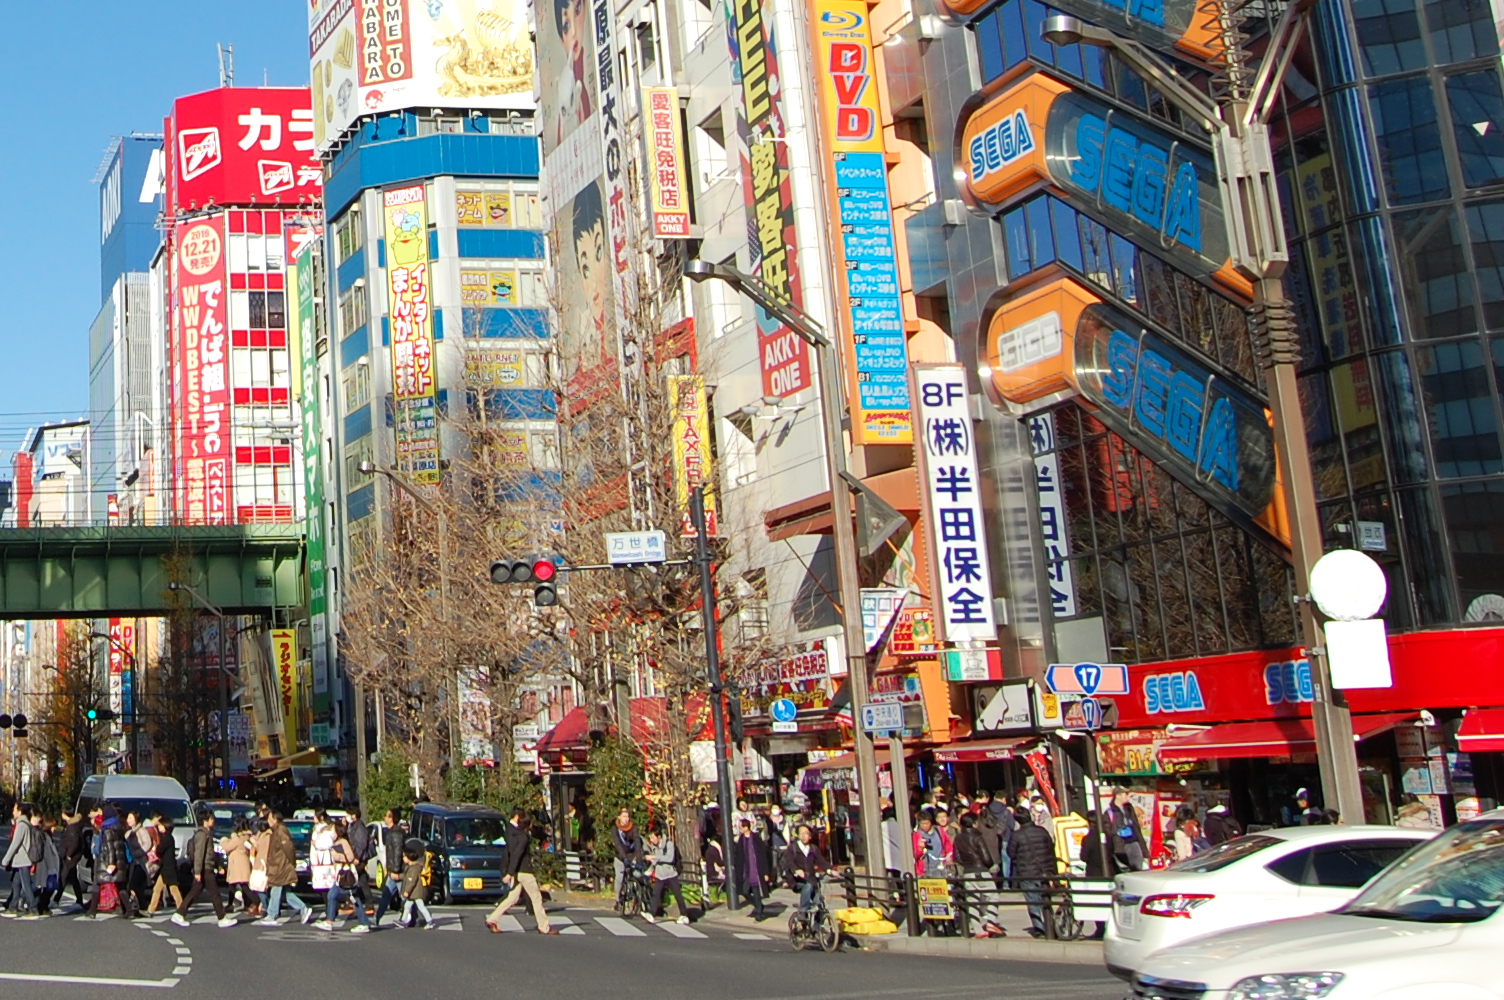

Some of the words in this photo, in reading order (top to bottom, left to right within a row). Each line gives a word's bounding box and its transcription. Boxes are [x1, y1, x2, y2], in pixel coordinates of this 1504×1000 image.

[390, 47, 402, 75] TO
[829, 42, 875, 142] DVD
[652, 93, 680, 209] 愛客旺免税店
[971, 112, 1032, 180] SEGA
[101, 157, 122, 246] AOKI
[457, 195, 481, 205] ネット
[1071, 113, 1202, 251] SEGA
[458, 207, 483, 218] ゲーム
[657, 214, 686, 225] AKKY
[184, 240, 217, 256] 12.21
[390, 267, 417, 398] まんが喫茶
[410, 263, 432, 396] インターネット
[764, 330, 801, 370] AKKY
[854, 335, 866, 344] 1F
[771, 363, 802, 396] ONE
[923, 382, 963, 407] 8F
[1103, 329, 1239, 492] SEGA
[926, 417, 988, 624] (株)半田保全
[612, 536, 660, 551] 万世橋
[280, 642, 293, 717] ラジオセンター
[1079, 667, 1098, 687] 17
[1146, 671, 1205, 714] SEGA
[1267, 660, 1313, 703] SEG
[1084, 701, 1093, 719] 17
